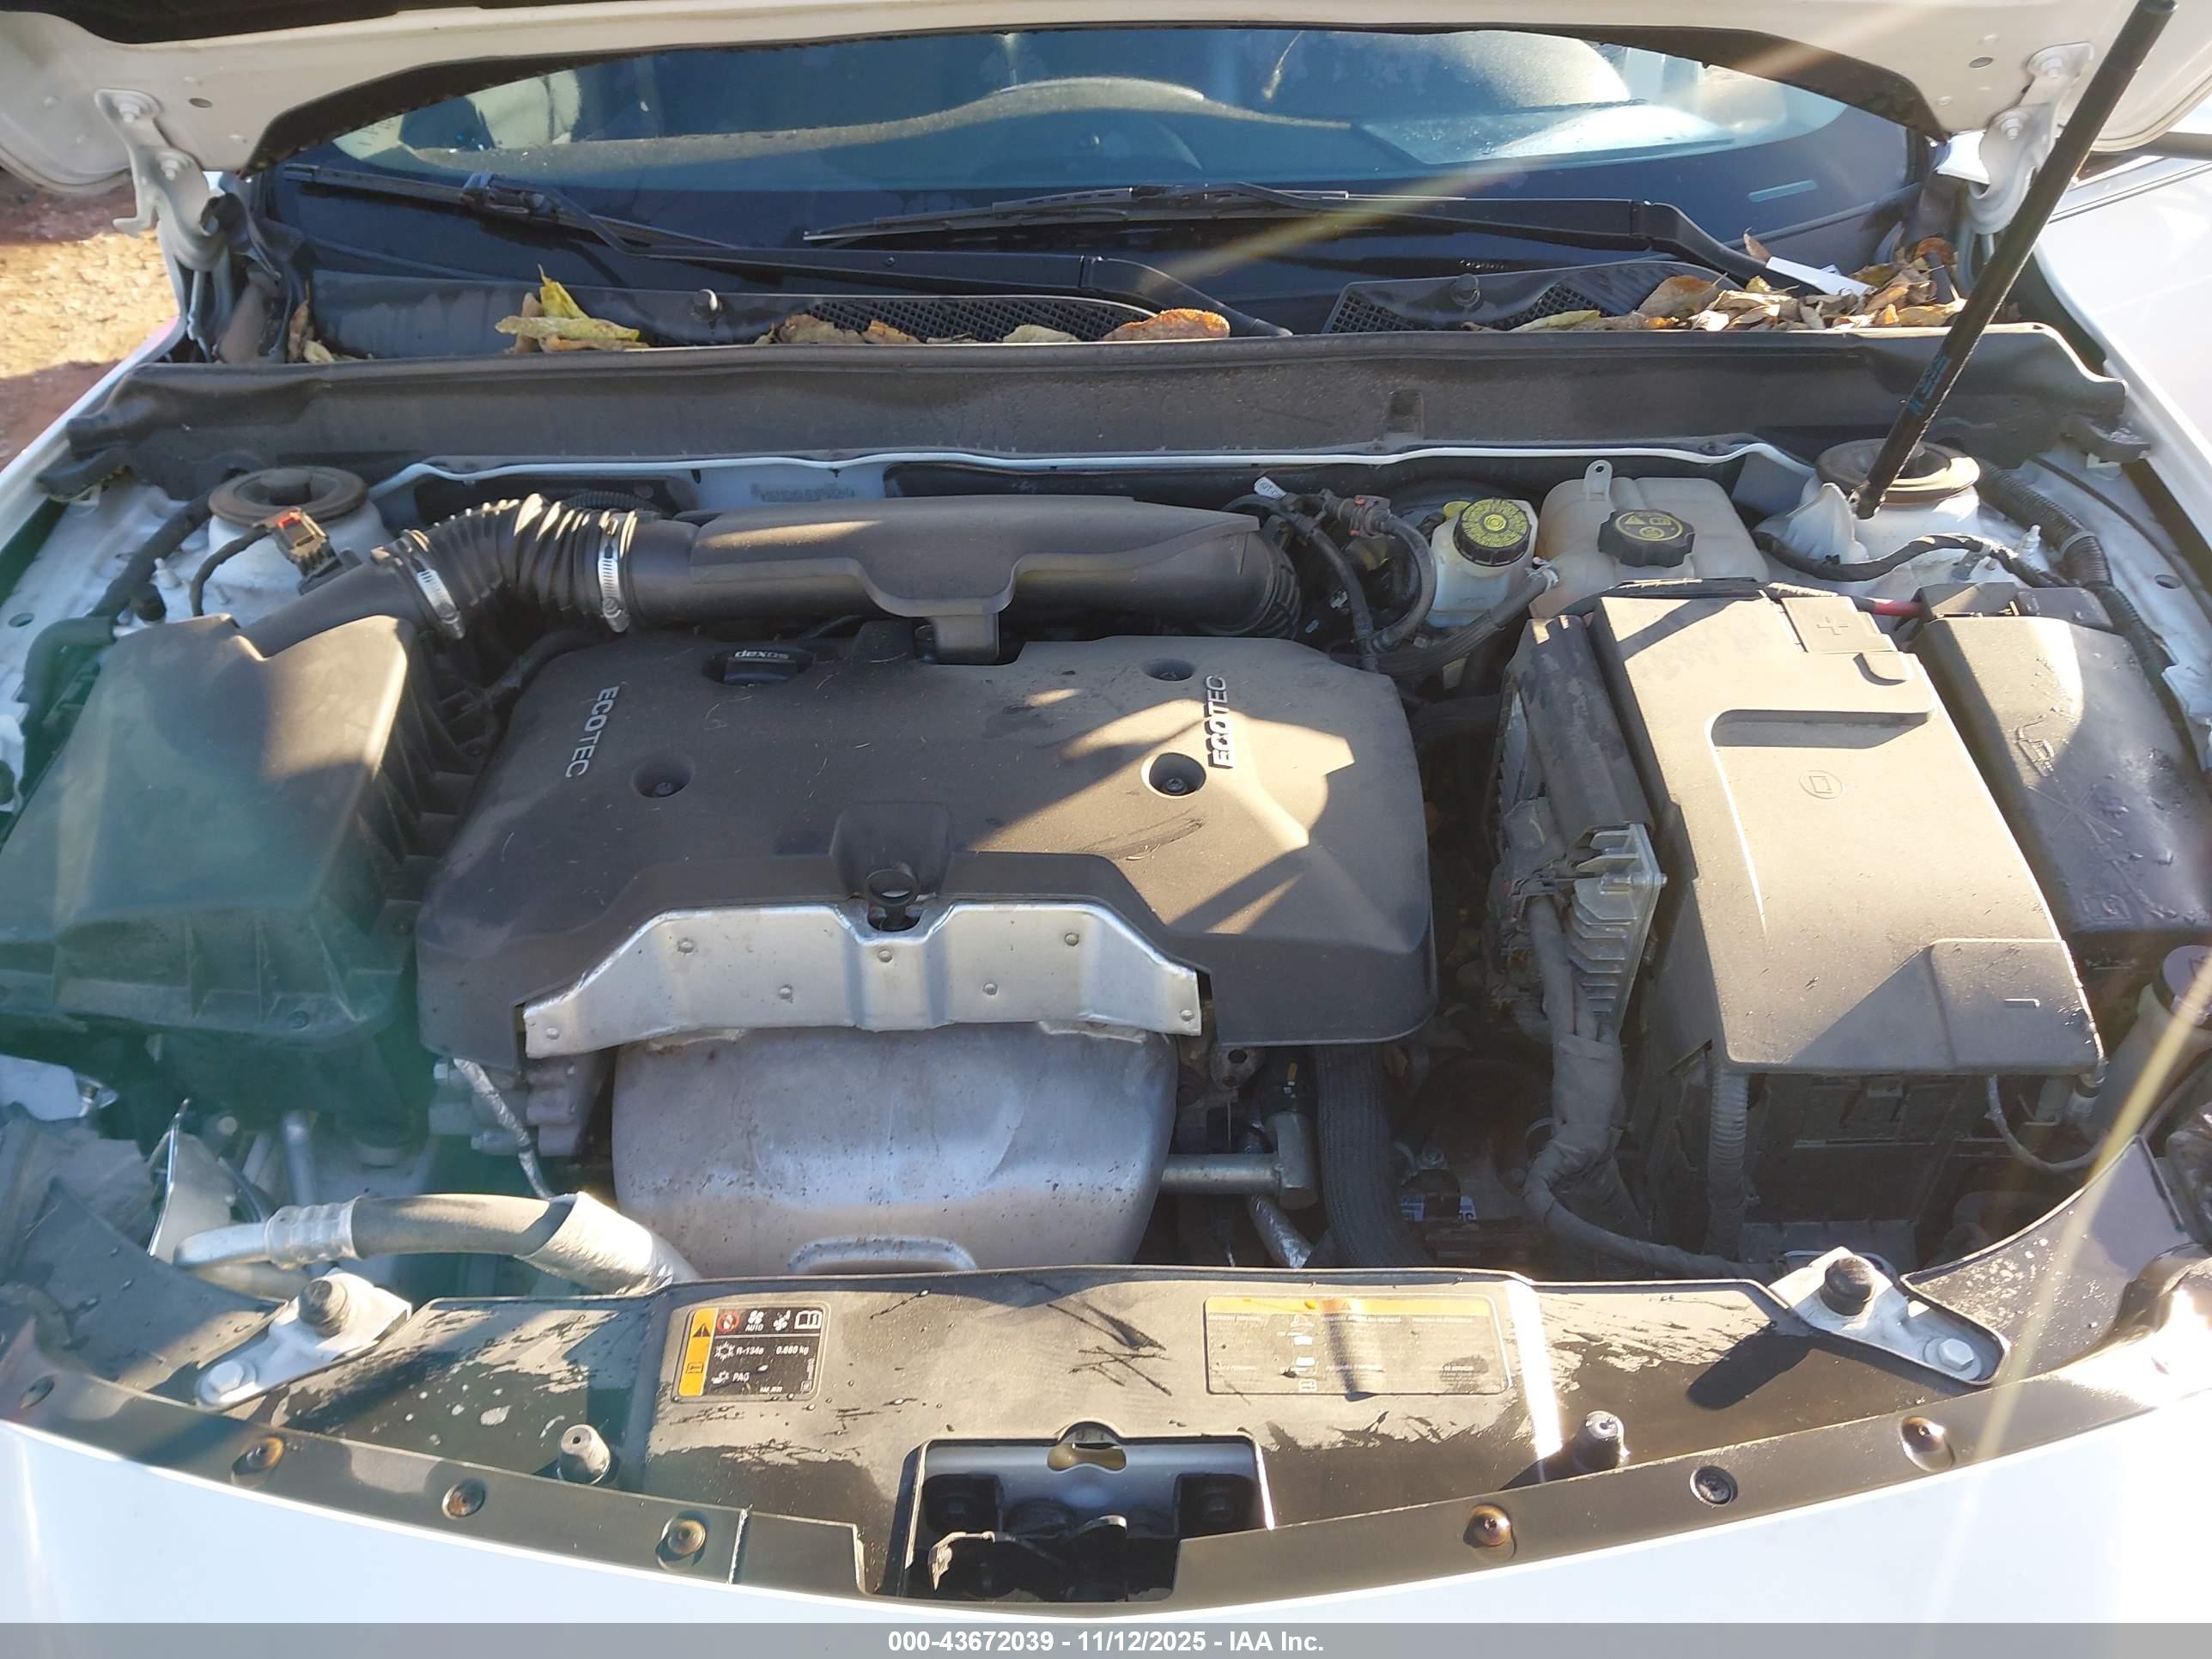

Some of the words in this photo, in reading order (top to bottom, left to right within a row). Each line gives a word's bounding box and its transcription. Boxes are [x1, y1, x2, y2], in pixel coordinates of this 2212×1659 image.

[735, 649, 789, 660] dexos
[1205, 675, 1235, 769] ECOTEC
[565, 685, 620, 778] ECOTEC
[744, 1323, 764, 1332] AUTO
[732, 1372, 750, 1382] PAG
